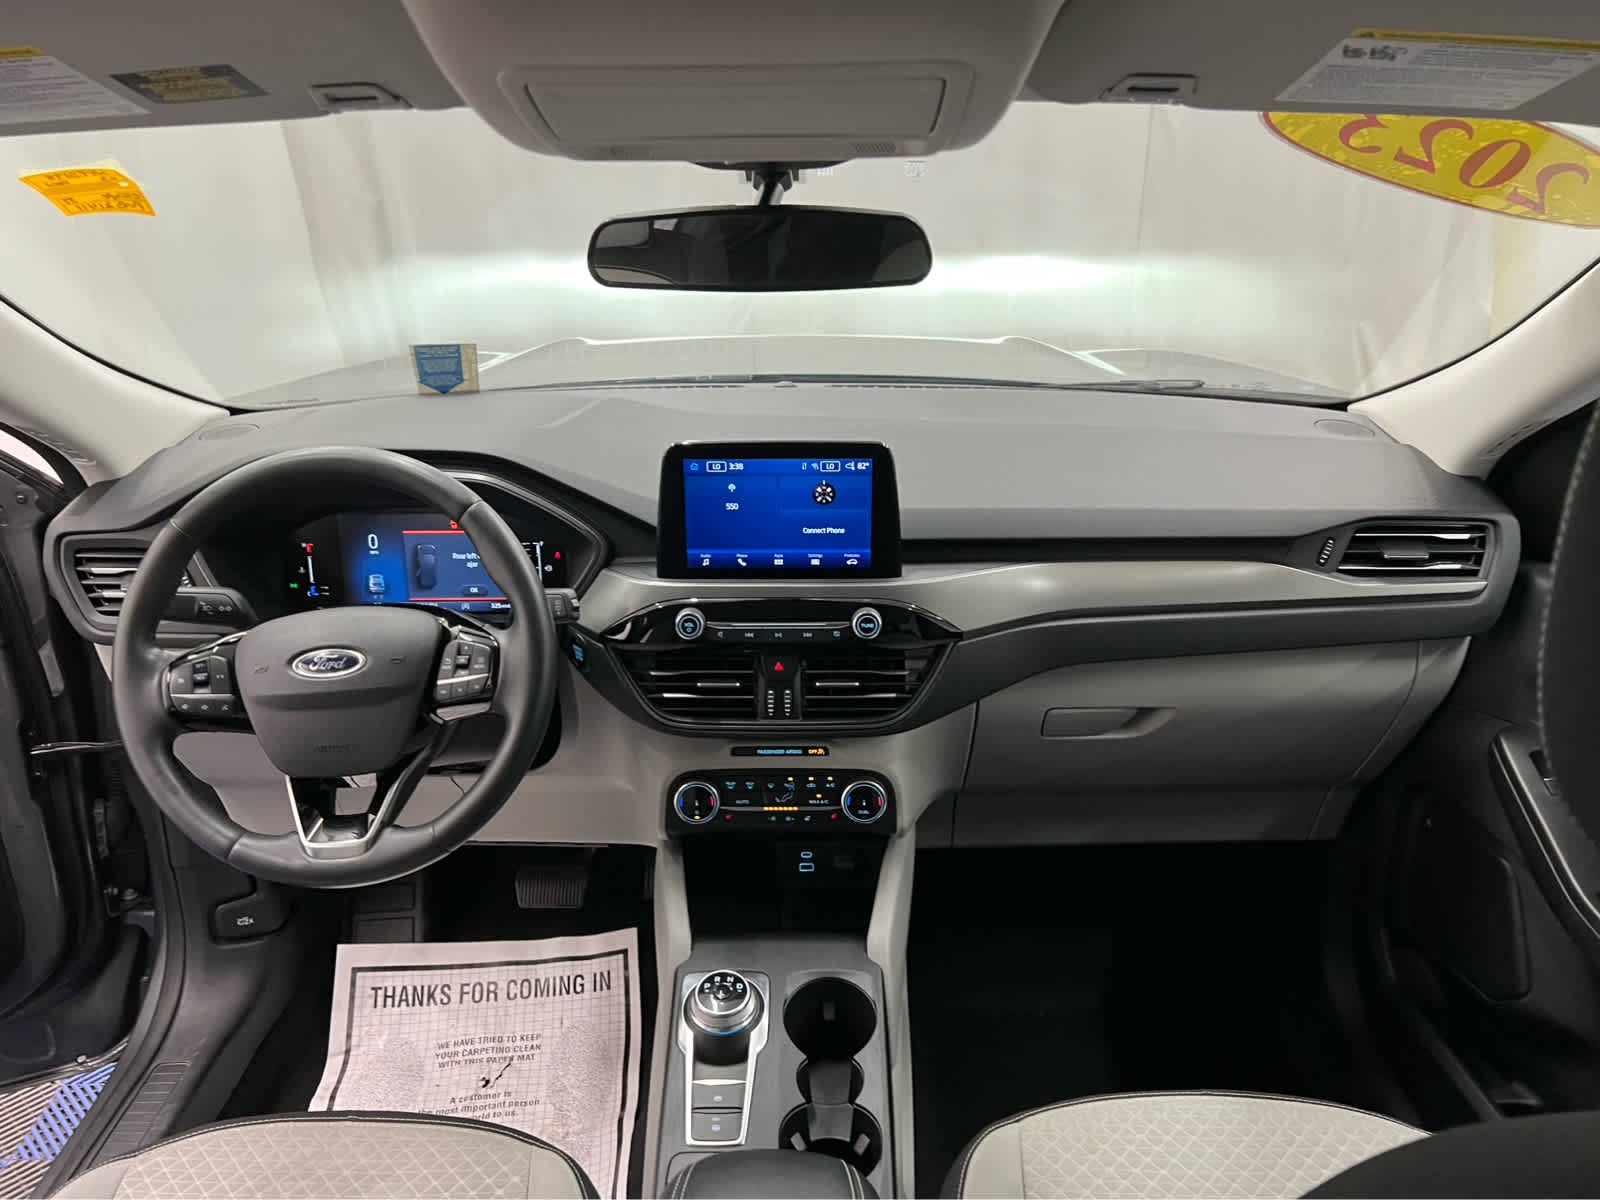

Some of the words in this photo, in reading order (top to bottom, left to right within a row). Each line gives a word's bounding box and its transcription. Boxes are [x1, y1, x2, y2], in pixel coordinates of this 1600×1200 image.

[367, 534, 378, 549] 0
[309, 654, 348, 671] Ford
[370, 984, 450, 1009] THANKS
[459, 981, 499, 1005] FOR
[506, 974, 585, 1001] COMING
[592, 969, 612, 993] IN
[437, 1041, 450, 1050] WE
[453, 1038, 476, 1048] HAVE
[478, 1036, 504, 1045] TRIED
[506, 1034, 518, 1043] TO
[519, 1032, 542, 1041] KEEP
[435, 1050, 459, 1060] YOUR
[461, 1046, 511, 1057] CARPETING
[513, 1043, 542, 1053] CLEAN
[438, 1060, 461, 1069] WITH
[486, 1055, 514, 1064] PAPER
[517, 1053, 535, 1061] MAT
[458, 1092, 501, 1103] customer
[503, 1090, 512, 1098] is
[434, 1106, 459, 1115] most
[460, 1100, 506, 1113] important
[508, 1099, 540, 1108] person
